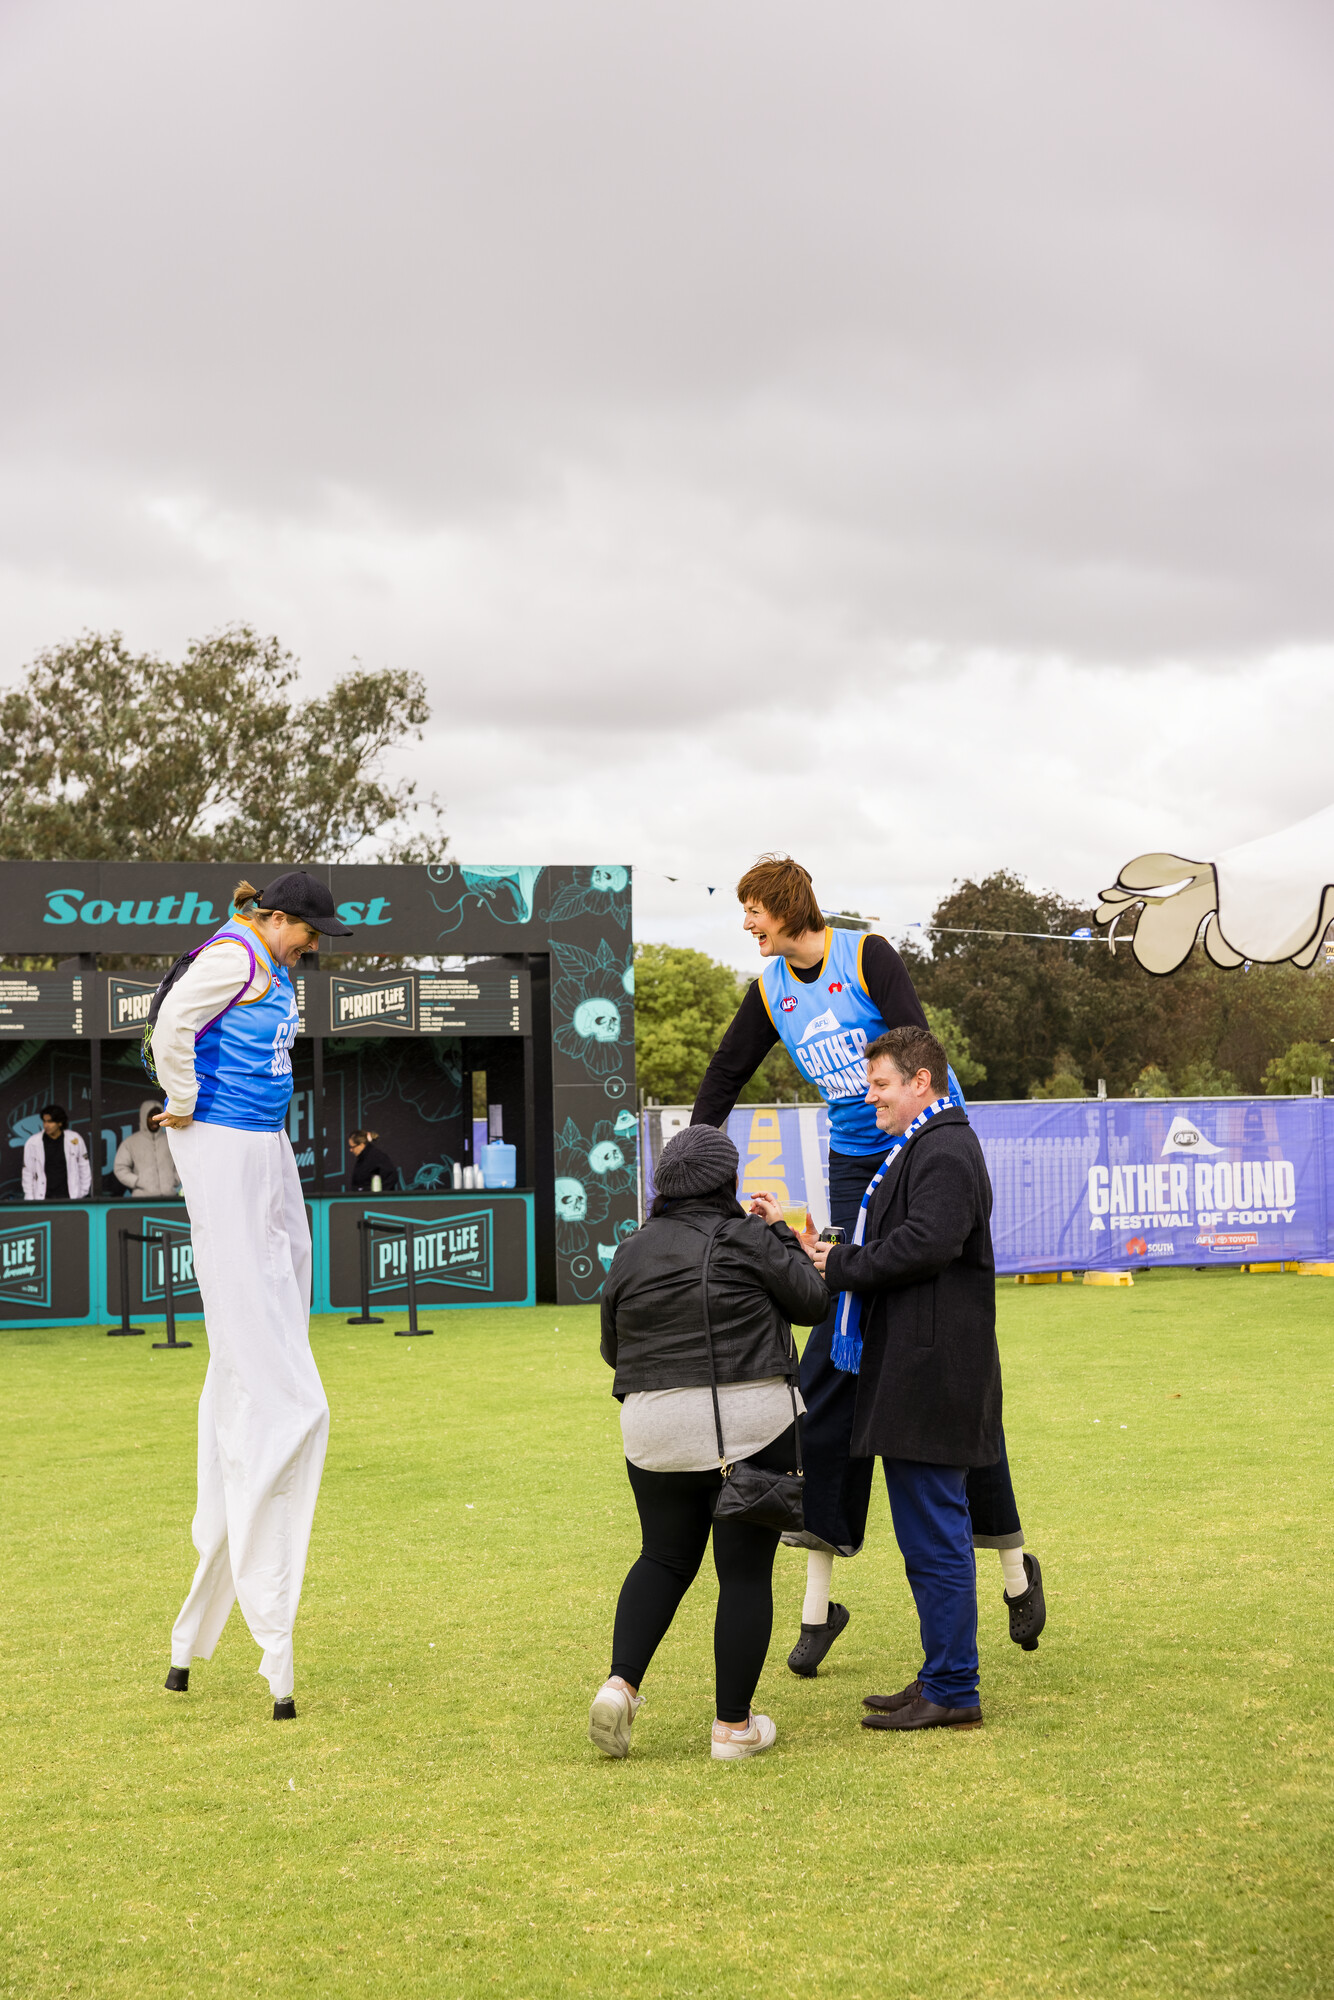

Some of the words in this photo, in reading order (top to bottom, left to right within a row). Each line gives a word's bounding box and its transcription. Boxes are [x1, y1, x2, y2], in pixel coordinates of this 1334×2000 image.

[43, 889, 220, 925] South
[795, 1027, 868, 1078] GATHER
[1174, 1132, 1198, 1145] AFL
[1088, 1163, 1189, 1215] GATHER
[1194, 1161, 1296, 1211] ROUND
[1089, 1217, 1106, 1231] A
[1110, 1214, 1193, 1230] FESTIVAL
[1197, 1212, 1223, 1226] OF
[1228, 1210, 1296, 1225] FOOTY
[1147, 1242, 1174, 1253] SOUTH
[1228, 1235, 1256, 1243] TOYOTA
